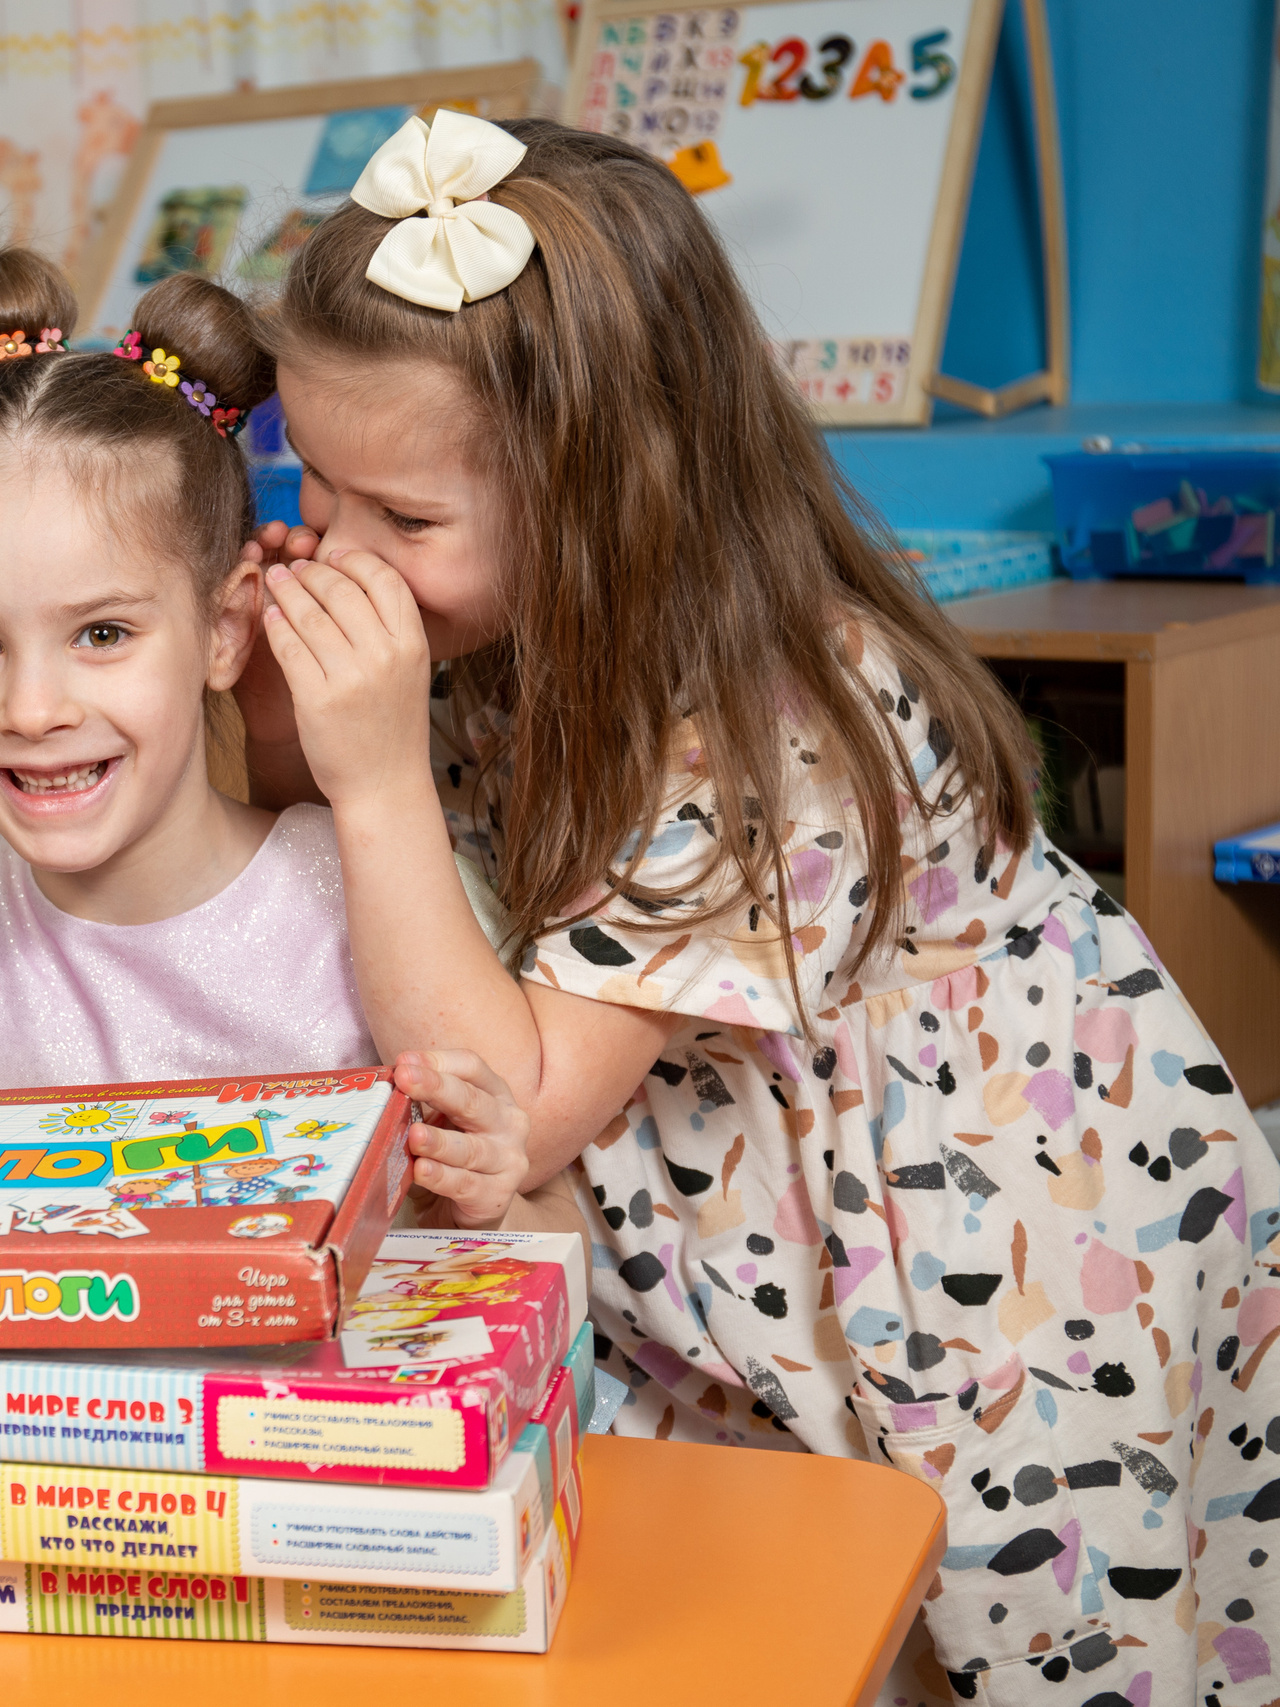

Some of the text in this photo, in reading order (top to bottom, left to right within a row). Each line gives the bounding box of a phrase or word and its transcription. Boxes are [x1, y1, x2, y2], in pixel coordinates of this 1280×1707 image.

[97, 1088, 107, 1097] в
[237, 1266, 289, 1289] Игра
[211, 1292, 296, 1313] для детей
[198, 1315, 223, 1327] от
[265, 1315, 298, 1327] лет
[7, 1392, 80, 1418] МИРЕ
[86, 1398, 165, 1423] СЛОВ
[177, 1398, 194, 1425] 3
[61, 1427, 186, 1445] ПРЕДЛОЖЕНИЯ
[10, 1483, 227, 1519] В МИРЕ СЛОВ 4
[67, 1514, 174, 1537] РАССКАЖИ,
[286, 1522, 324, 1533] УЧИМСЯ
[389, 1528, 421, 1538] СЛОВА
[40, 1536, 198, 1559] КТО ЧТО ДЕЛАЕТ
[40, 1571, 249, 1604] В МИРЕ СЛОВ 1
[320, 1584, 357, 1594] УЧИМСЯ
[95, 1603, 196, 1622] ПРЕДЛОГИ
